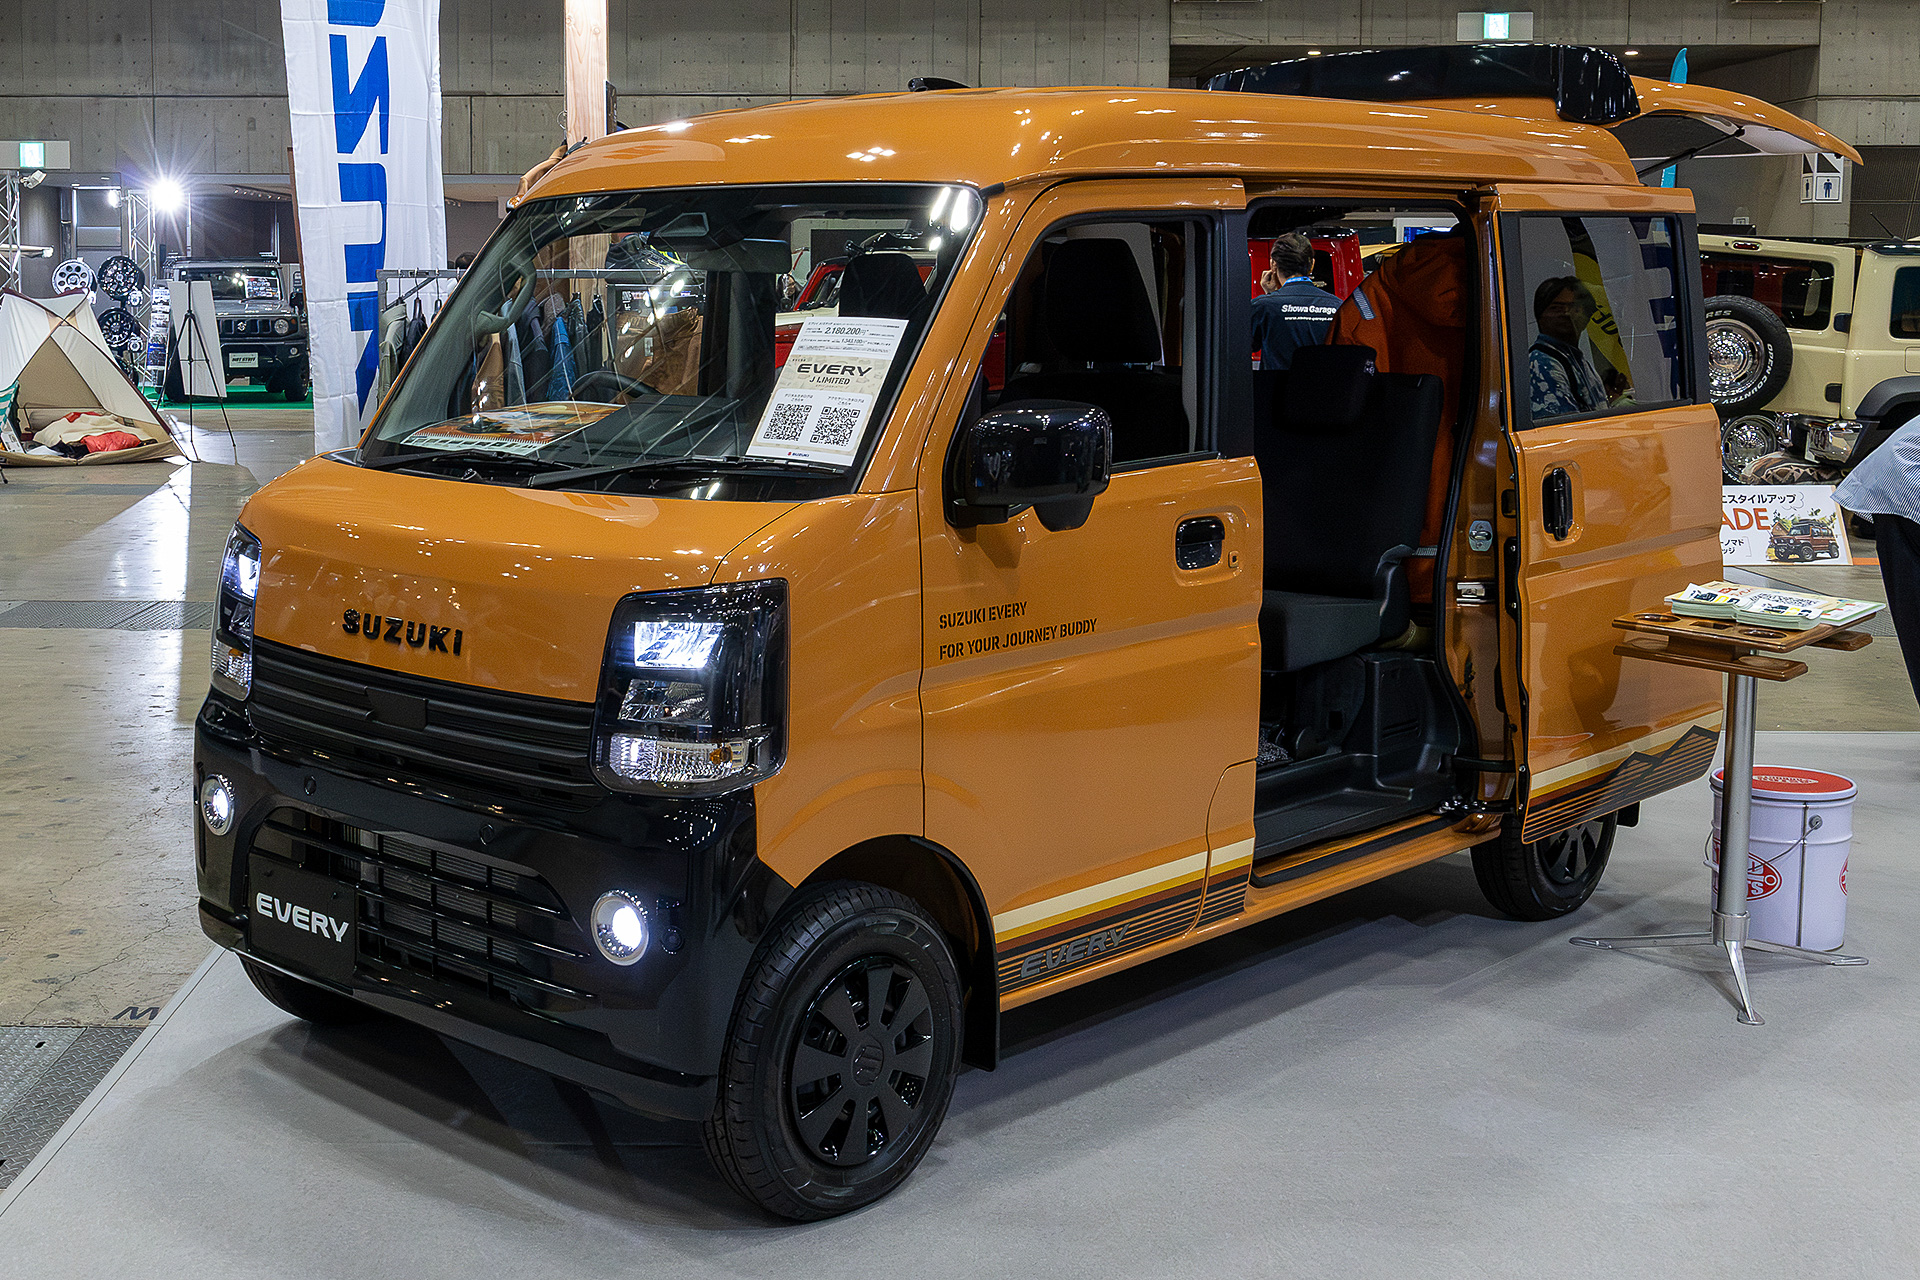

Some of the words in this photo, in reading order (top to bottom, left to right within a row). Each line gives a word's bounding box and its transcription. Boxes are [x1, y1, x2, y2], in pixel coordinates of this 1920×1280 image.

[1281, 304, 1308, 313] Showa
[1309, 305, 1337, 315] Garage
[797, 363, 872, 377] EVERY
[1765, 342, 1775, 375] OPEN
[816, 377, 851, 385] LIMITED
[1722, 375, 1769, 405] COUNTRY
[939, 607, 986, 630] SUZUKI
[988, 600, 1028, 622] EVERY
[341, 608, 463, 657] SUZUKI
[939, 641, 965, 660] FOR
[967, 635, 1000, 655] YOUR
[1002, 625, 1058, 649] JOURNEY
[1059, 617, 1098, 638] BUDDY
[256, 892, 350, 943] EVERY
[1020, 923, 1131, 979] EVERY
